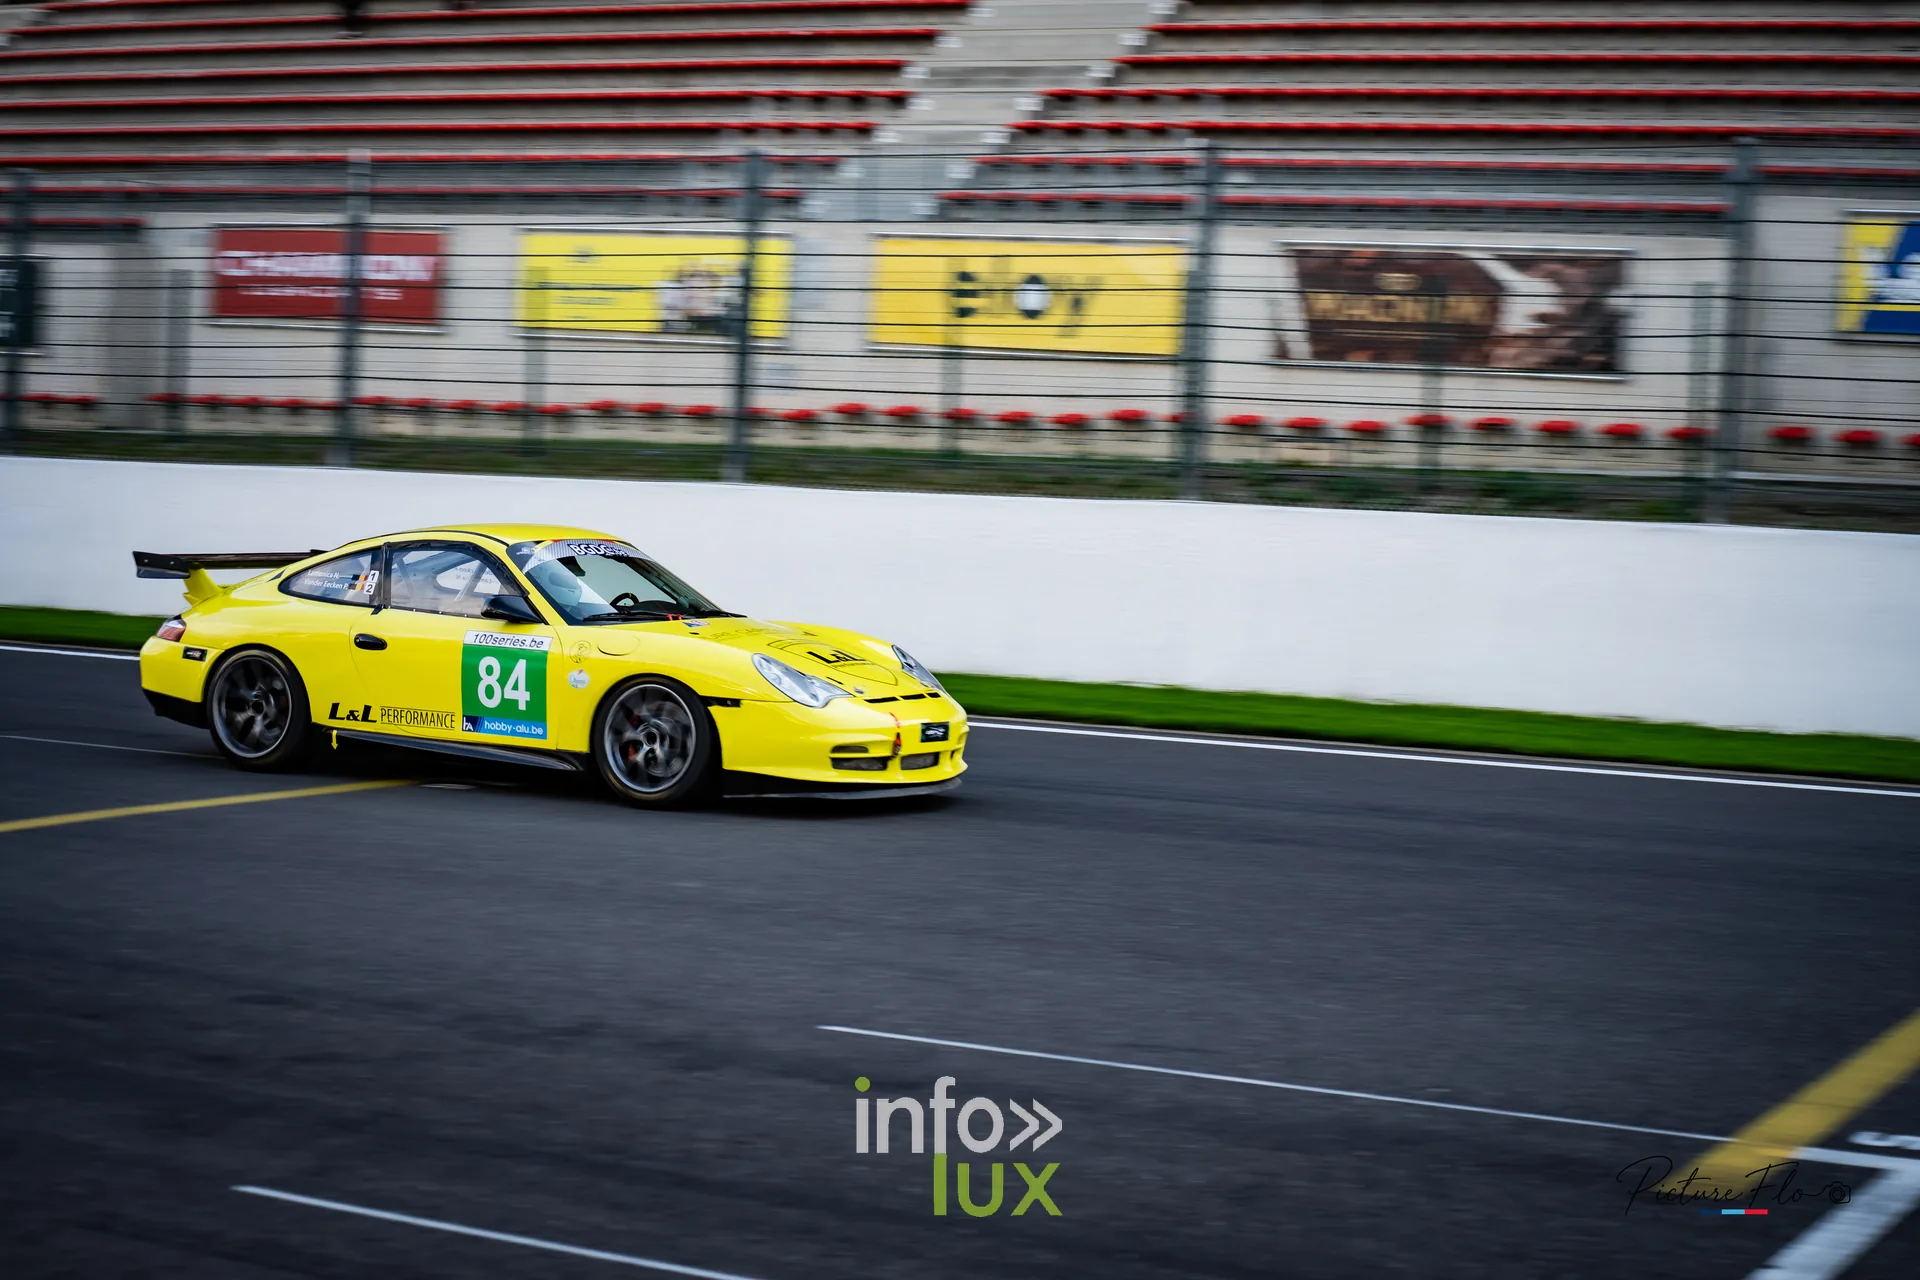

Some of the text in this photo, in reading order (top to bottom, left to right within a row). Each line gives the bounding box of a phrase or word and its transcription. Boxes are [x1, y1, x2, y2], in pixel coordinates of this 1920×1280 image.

[304, 579, 323, 587] Vander
[473, 633, 544, 649] 100series.be
[477, 656, 531, 711] 84
[328, 702, 456, 729] L&L PERFORMANCE
[484, 720, 544, 736] hobby-alu.be
